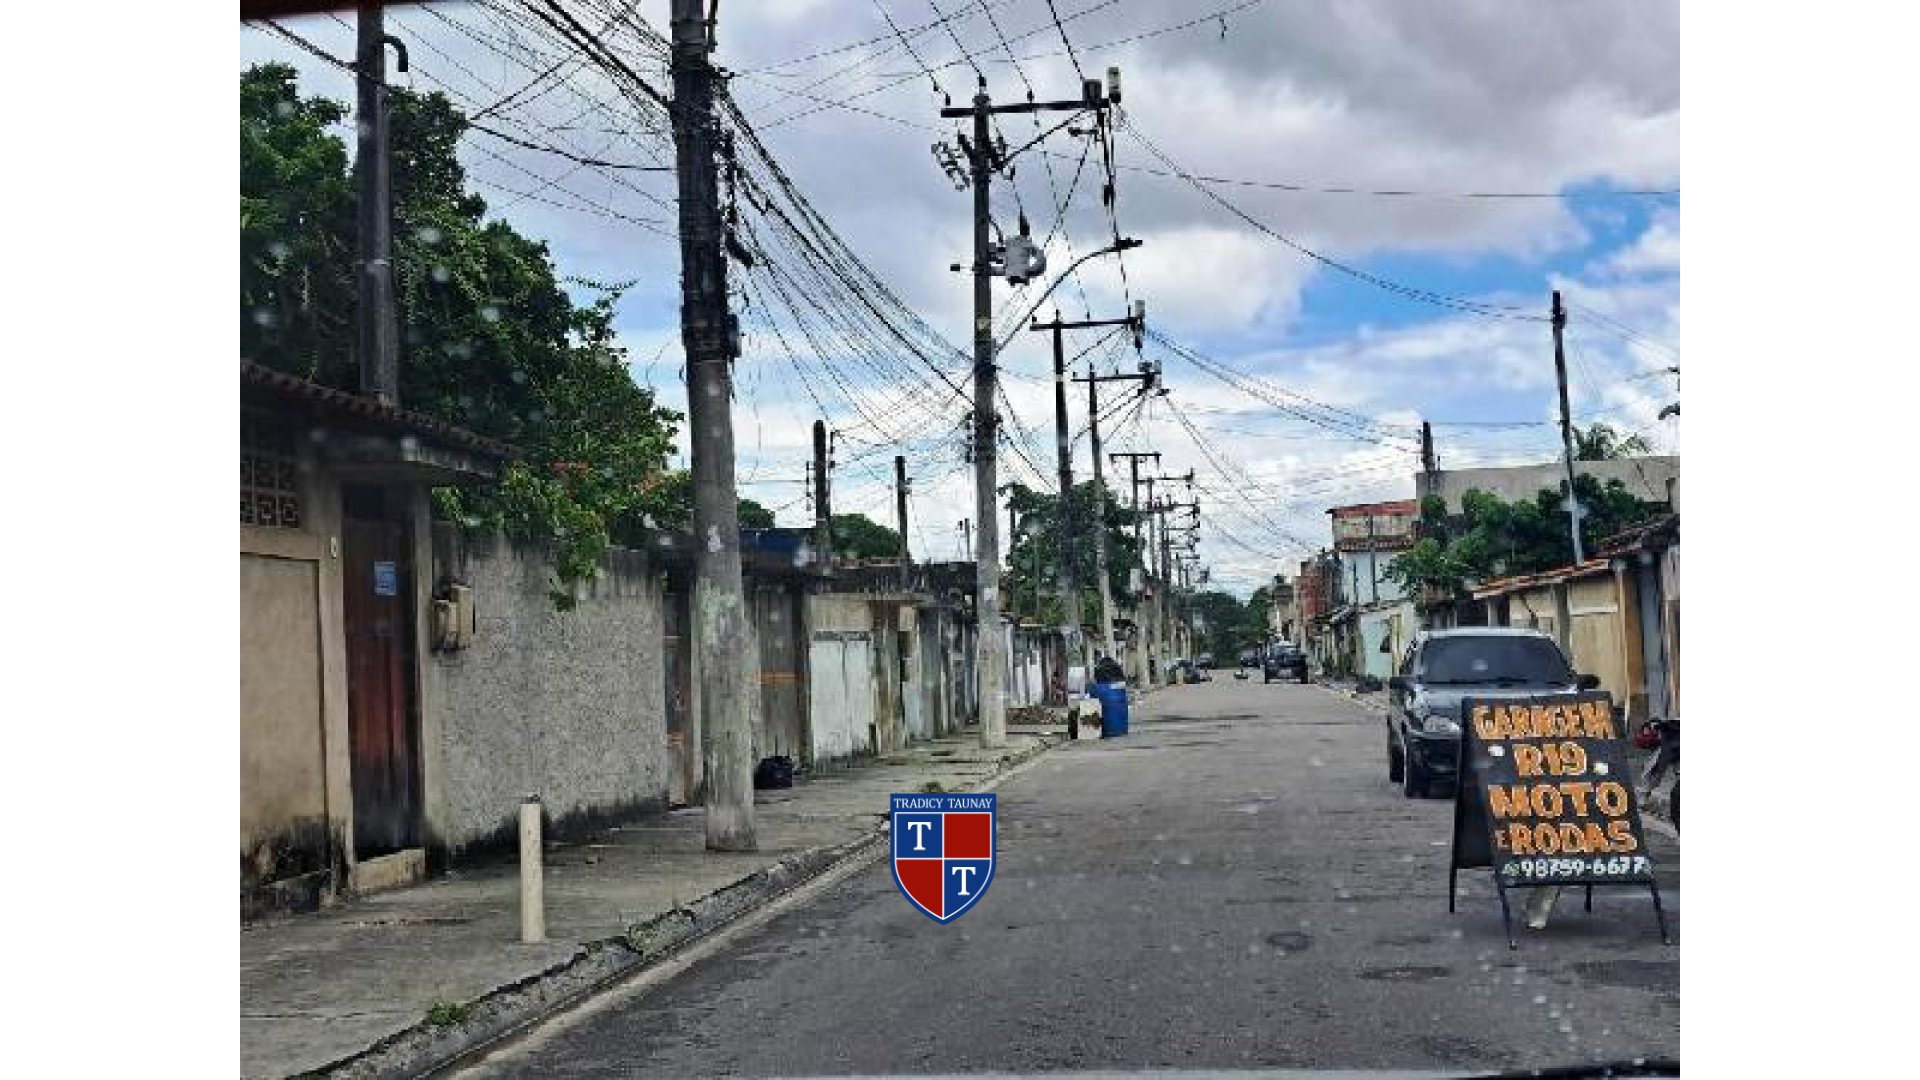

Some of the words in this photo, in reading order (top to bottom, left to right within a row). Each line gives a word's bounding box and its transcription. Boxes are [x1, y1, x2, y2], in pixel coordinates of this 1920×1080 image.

[1472, 701, 1616, 740] GARAGEM
[1512, 741, 1587, 776] R19
[1488, 781, 1628, 819] MOTO
[1509, 821, 1638, 855] RODAS
